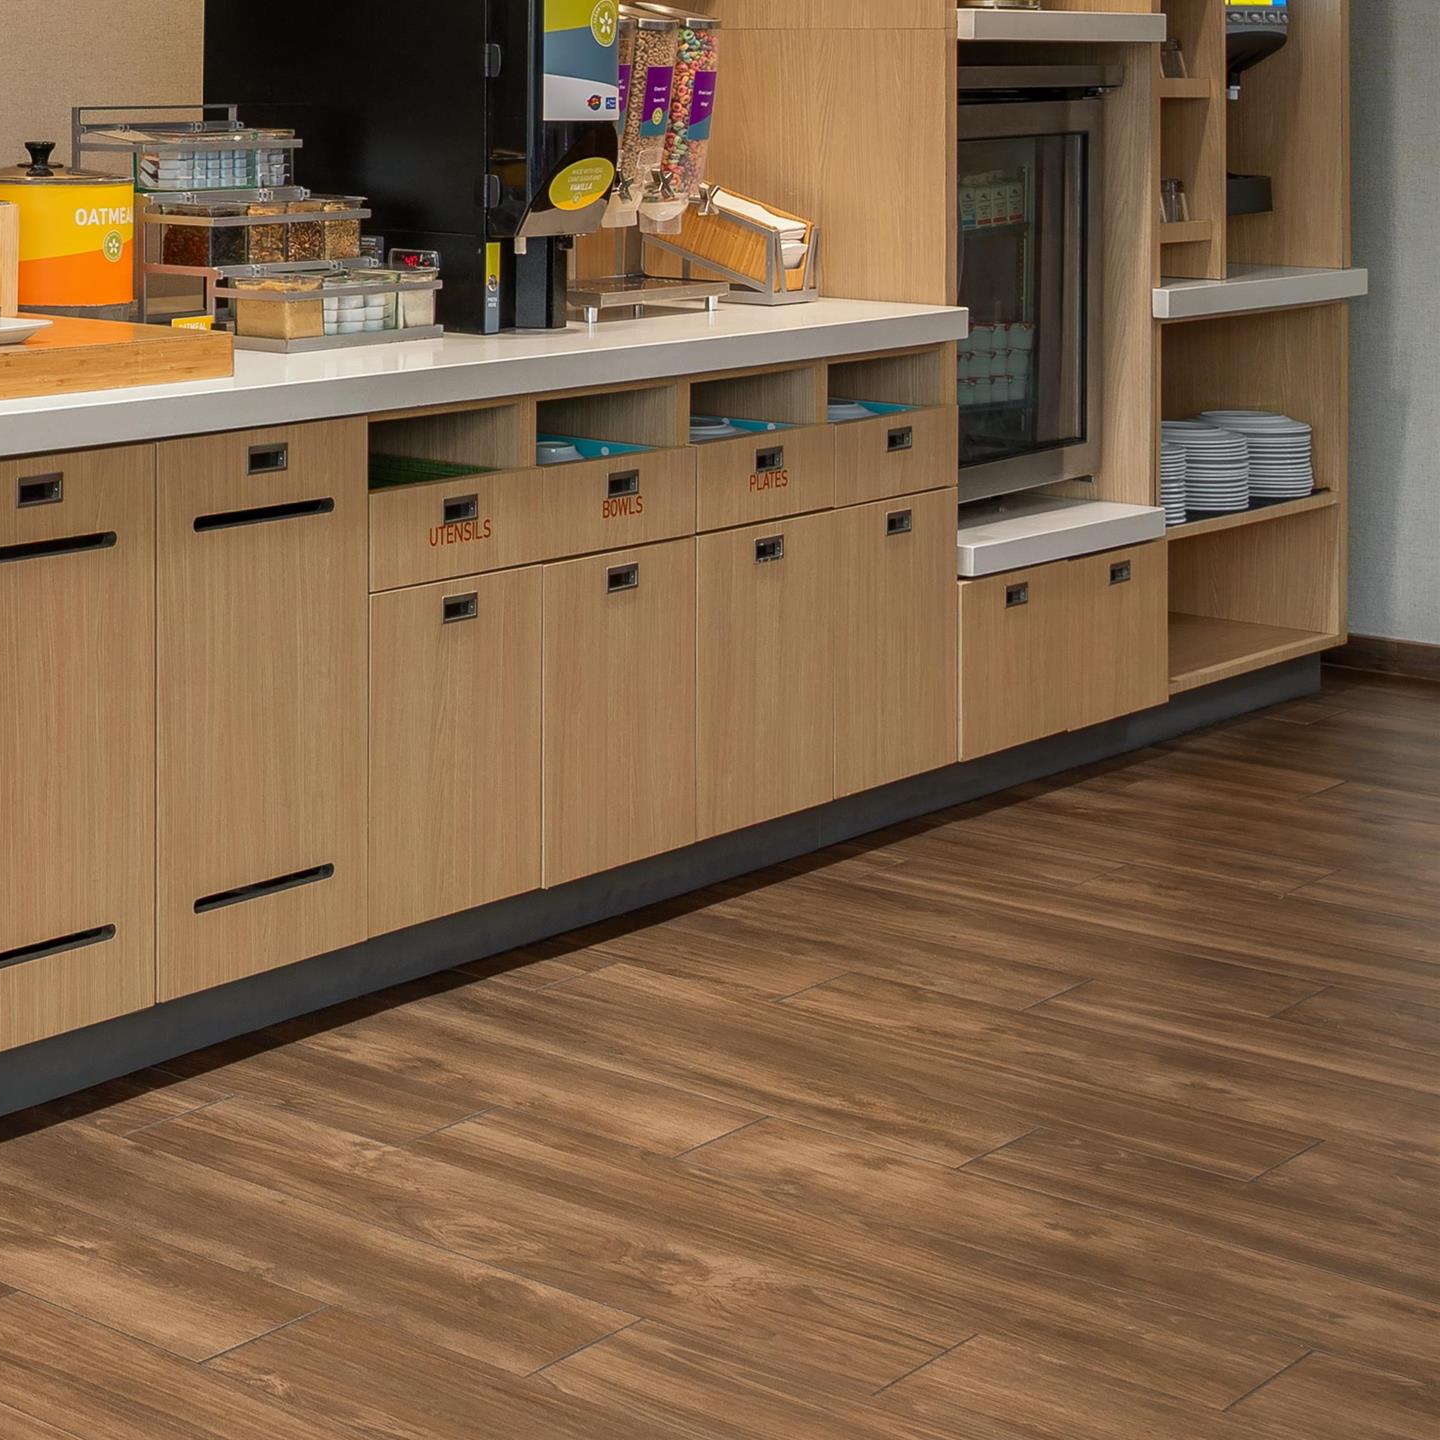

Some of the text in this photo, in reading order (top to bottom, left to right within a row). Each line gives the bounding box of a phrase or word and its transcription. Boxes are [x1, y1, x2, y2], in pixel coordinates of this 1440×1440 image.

[75, 207, 133, 226] OATMEA
[750, 469, 788, 492] PLATES
[603, 495, 643, 519] BOWLS
[429, 519, 491, 548] UTENSILS
